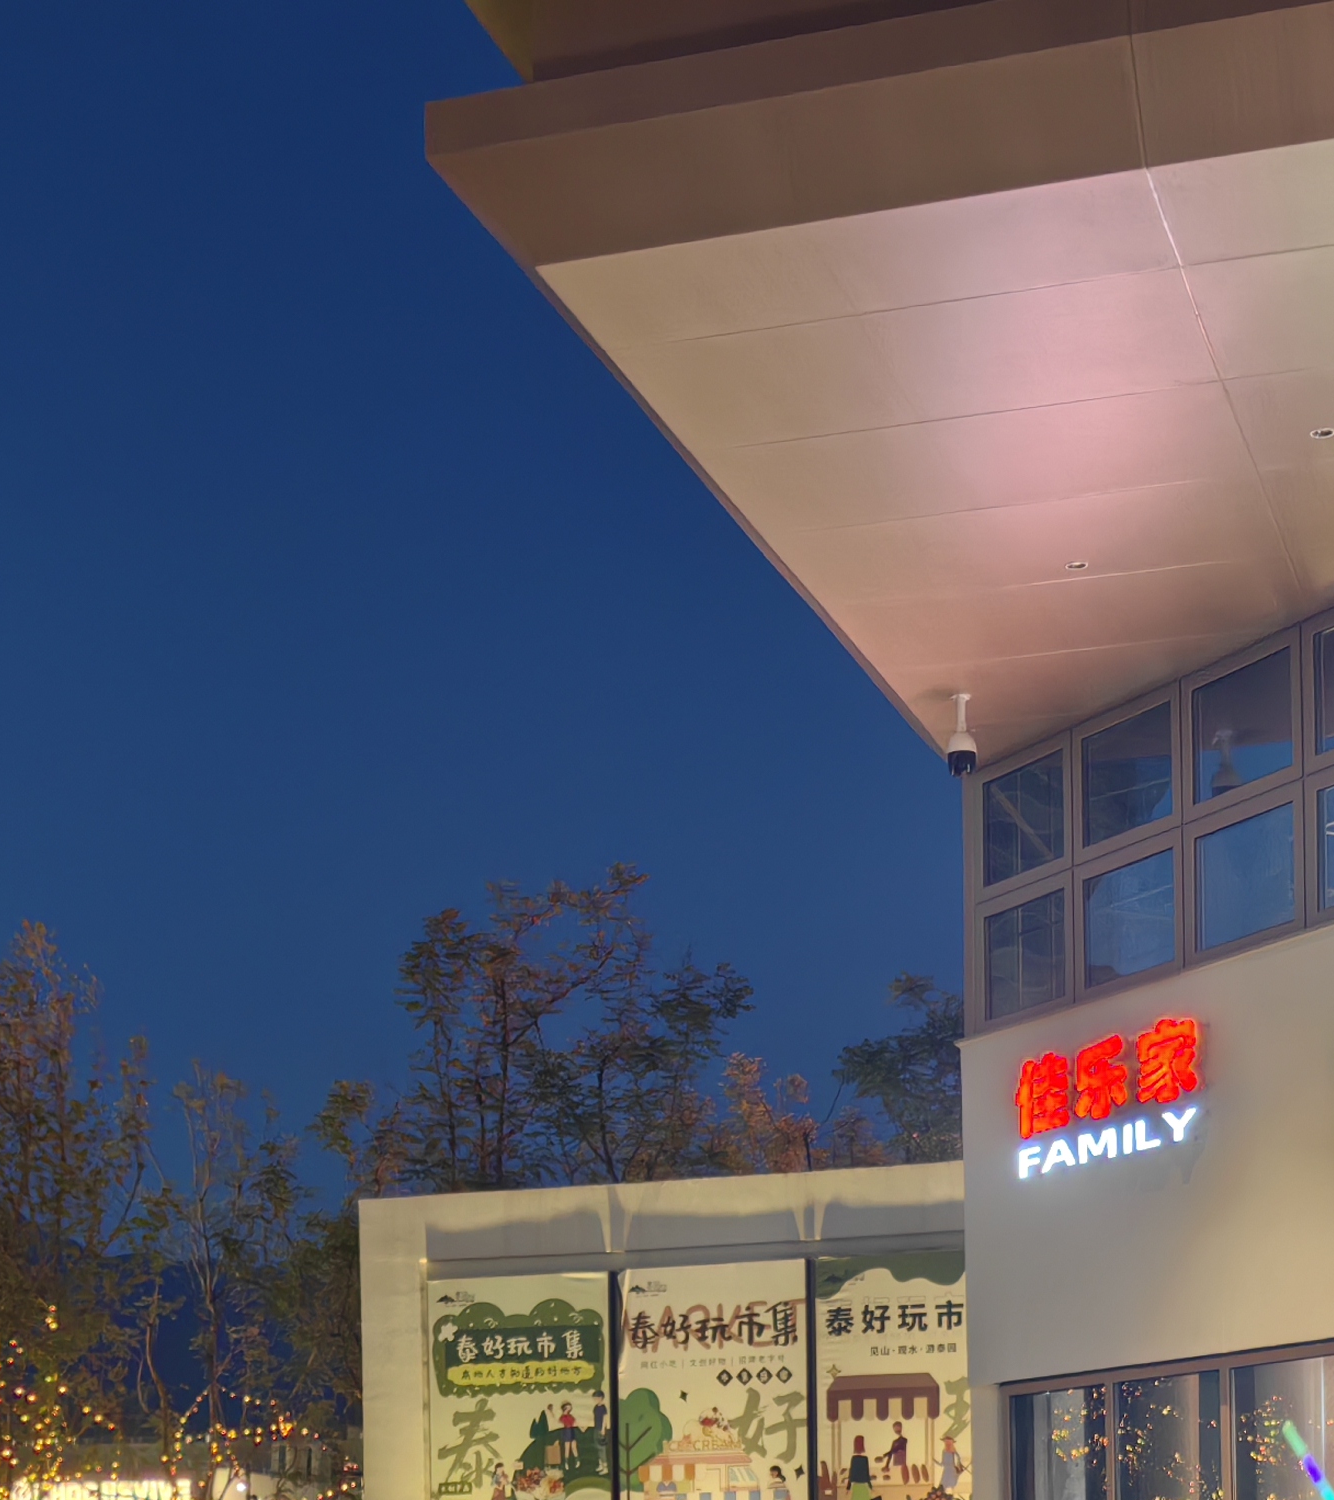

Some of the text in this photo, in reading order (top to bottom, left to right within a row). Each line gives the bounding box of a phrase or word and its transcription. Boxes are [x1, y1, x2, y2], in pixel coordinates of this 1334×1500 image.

[1015, 1018, 1198, 1140] 佳乐家
[1017, 1106, 1198, 1180] FAMILY
[456, 1329, 585, 1363] 泰好玩市集
[629, 1300, 799, 1350] 泰好玩市集
[825, 1299, 965, 1337] 泰好玩市
[728, 1386, 807, 1464] 好
